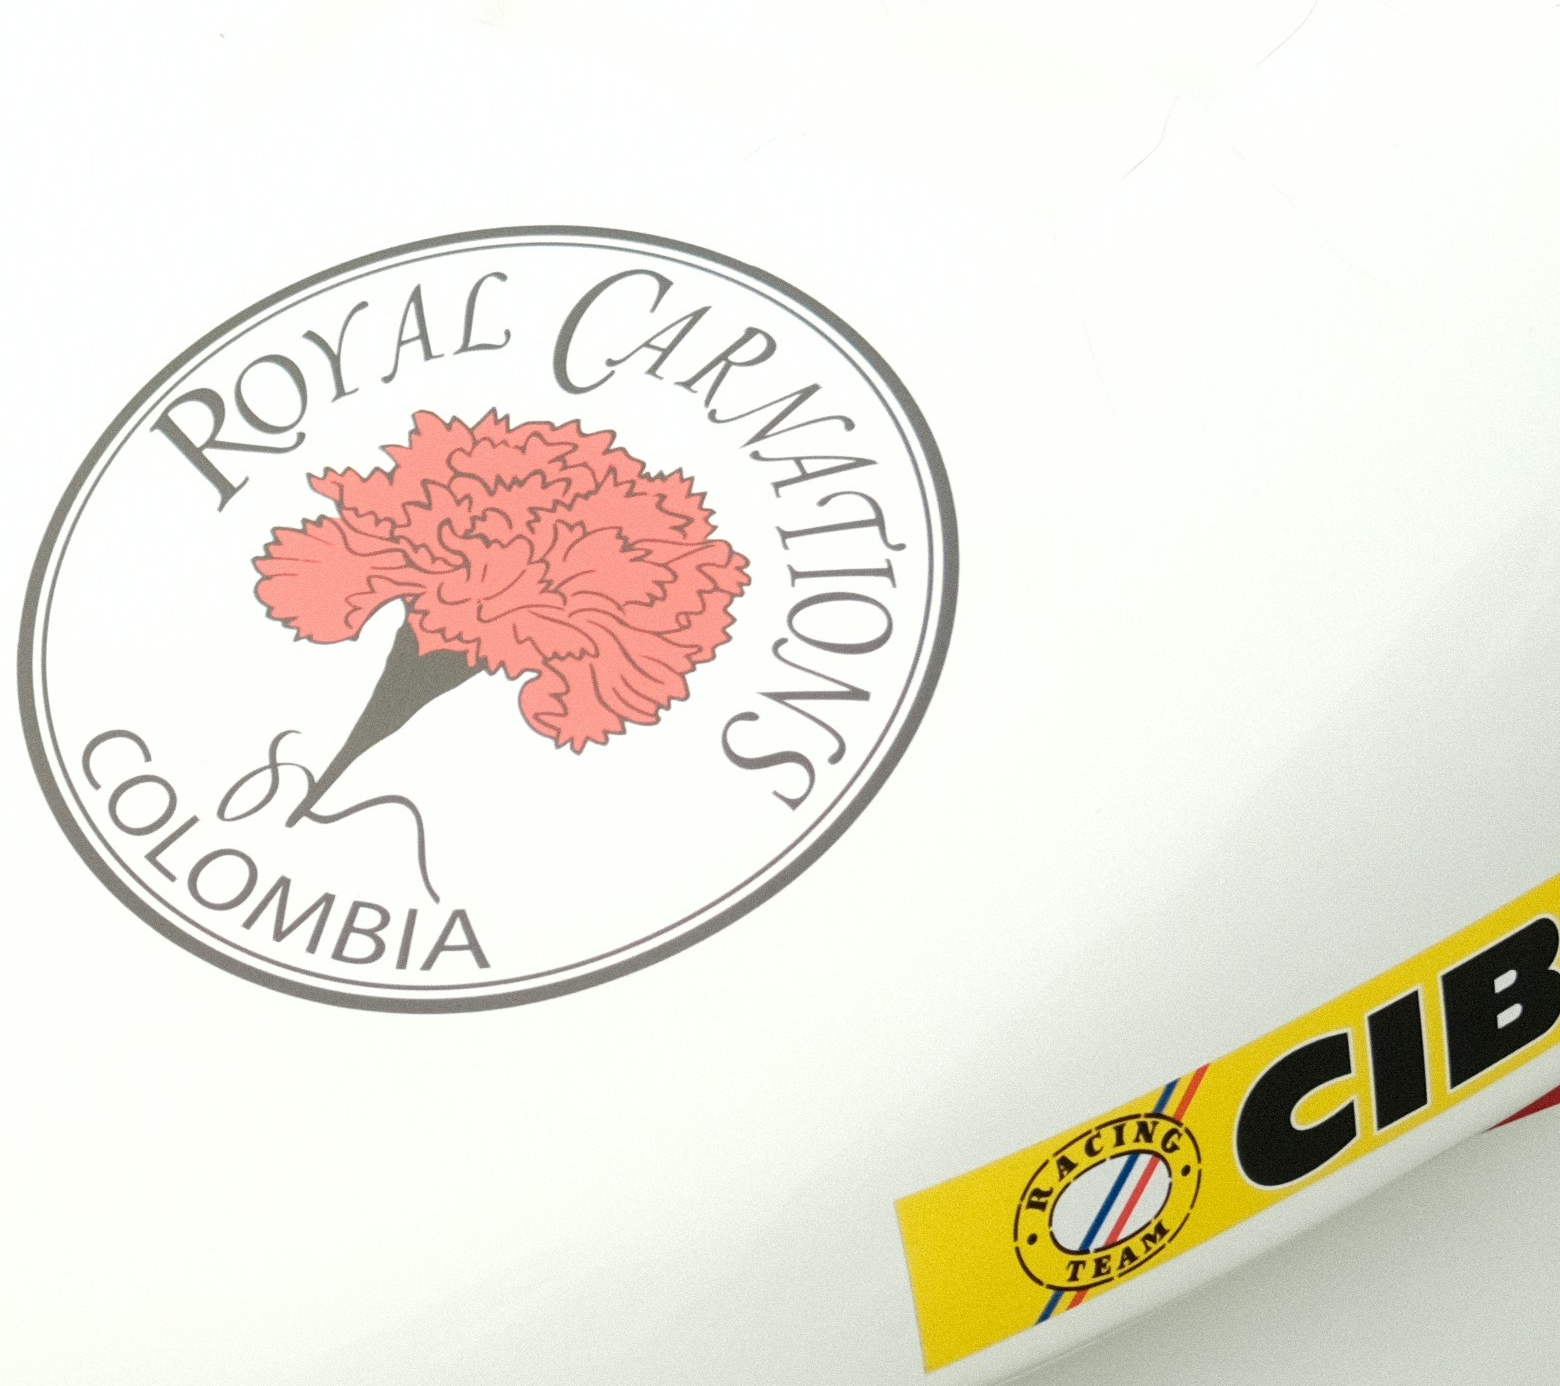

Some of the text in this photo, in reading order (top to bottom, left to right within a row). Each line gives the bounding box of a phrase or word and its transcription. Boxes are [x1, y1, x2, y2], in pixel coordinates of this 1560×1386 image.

[149, 268, 907, 812] ROYAL CARNATIONS
[81, 728, 492, 972] COLOMBIA
[1026, 1120, 1184, 1213] RACING
[1066, 1220, 1170, 1282] TEAM
